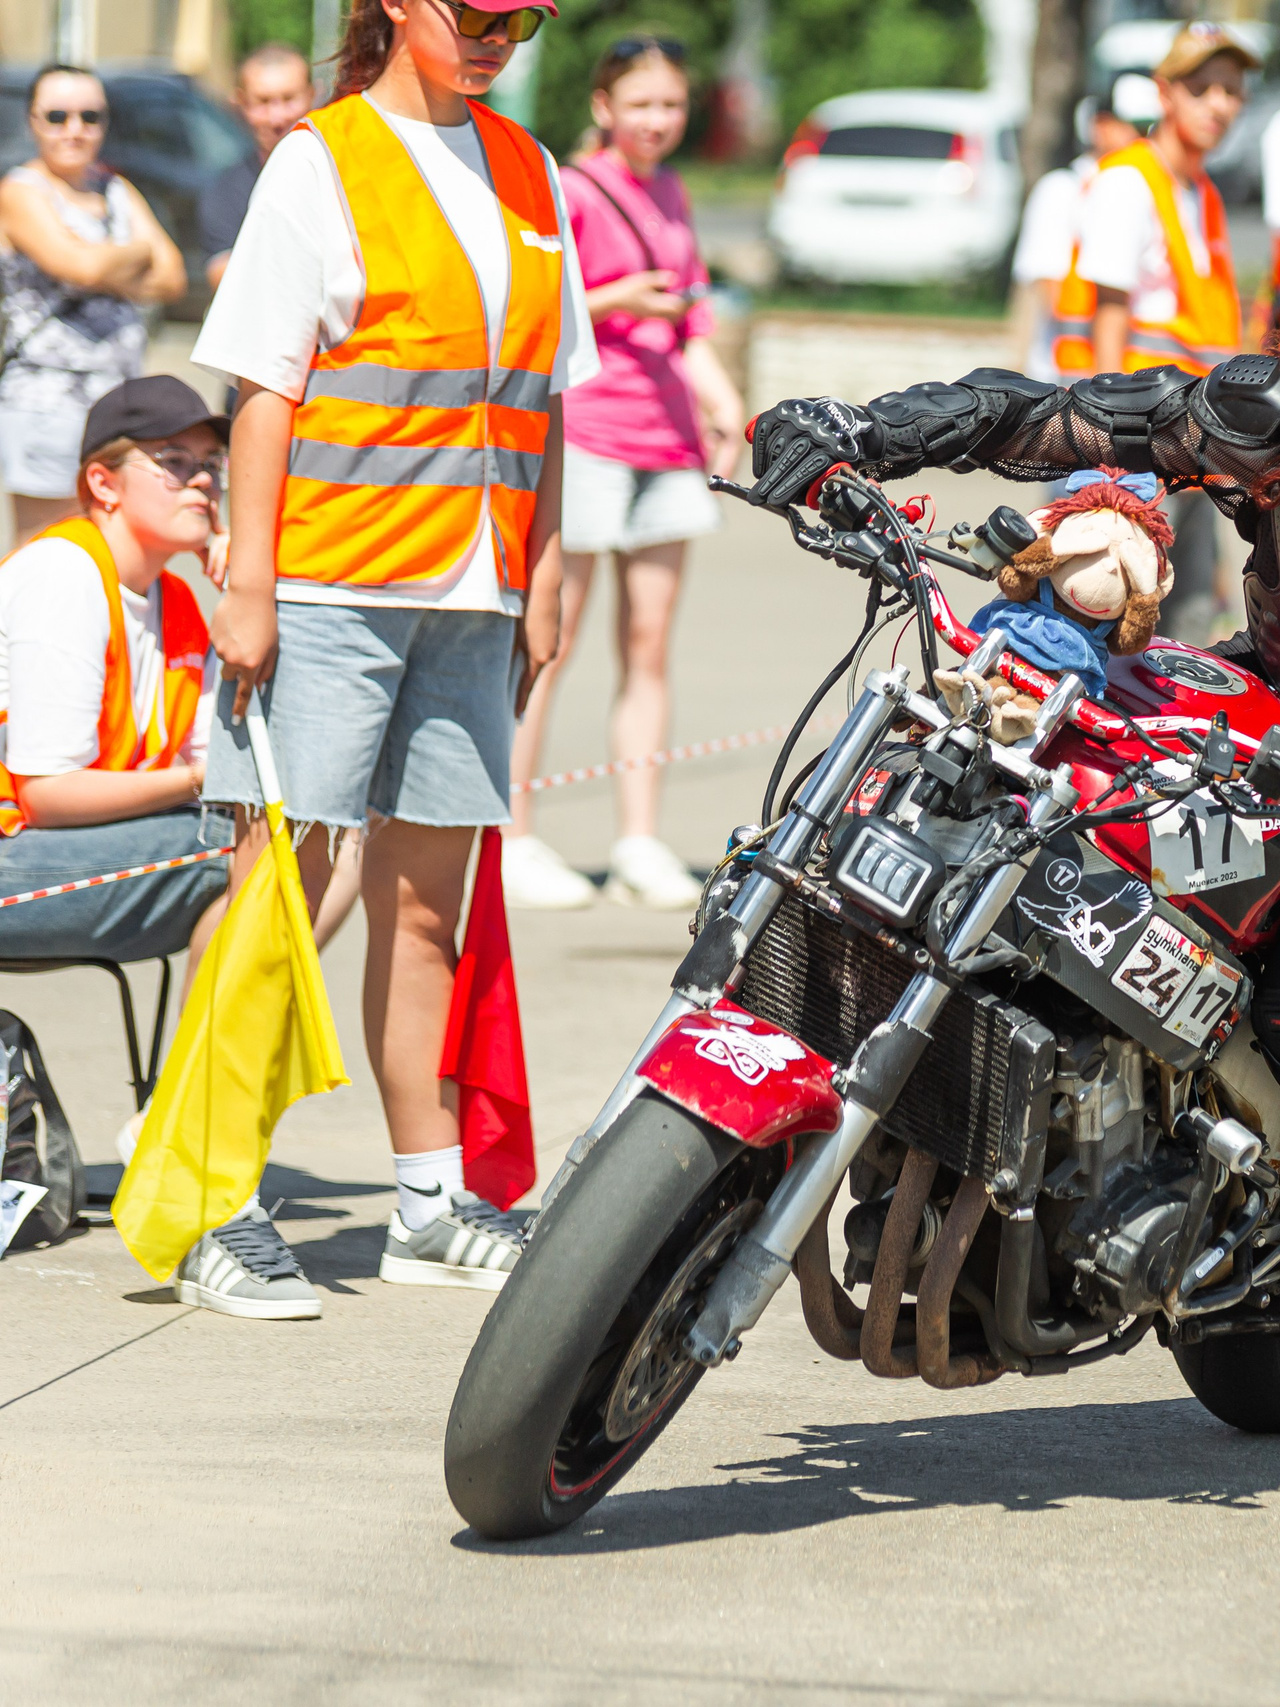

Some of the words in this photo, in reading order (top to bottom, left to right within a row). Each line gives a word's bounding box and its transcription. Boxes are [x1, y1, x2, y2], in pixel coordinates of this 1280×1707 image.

[1179, 805, 1233, 871] 17
[1053, 864, 1076, 887] 17
[1220, 871, 1238, 883] 2023
[1143, 929, 1200, 973] gymkhana
[1120, 945, 1181, 1008] 24
[1190, 982, 1232, 1025] 17
